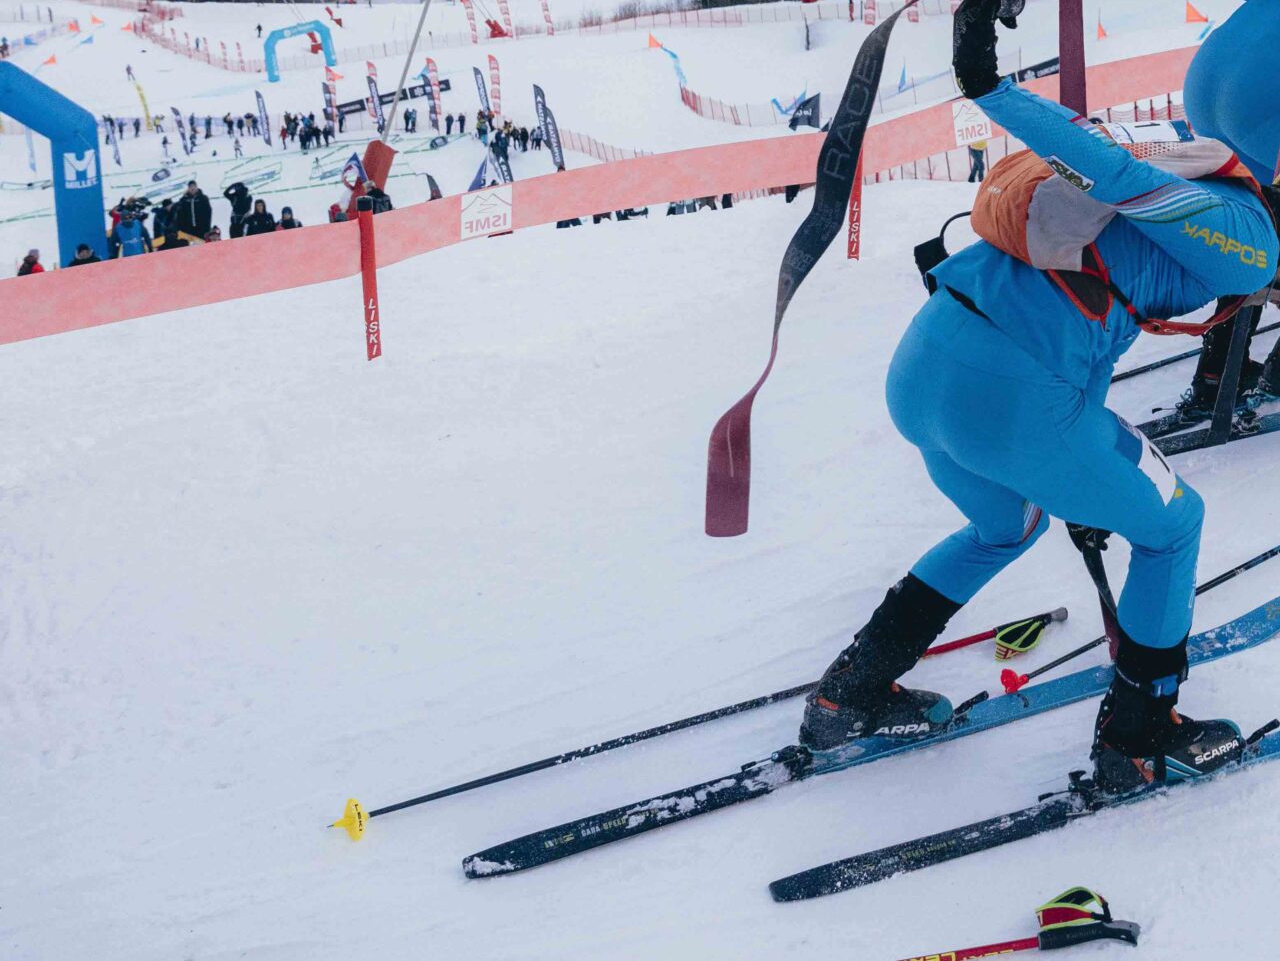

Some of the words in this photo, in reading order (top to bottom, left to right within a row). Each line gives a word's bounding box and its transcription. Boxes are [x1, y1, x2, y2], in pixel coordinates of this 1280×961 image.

[823, 58, 878, 181] RACE
[850, 201, 860, 252] LISKI
[1181, 221, 1267, 269] KARPOS
[368, 298, 378, 355] LISKI
[872, 722, 930, 736] ARPA
[1194, 739, 1240, 765] SCARPA
